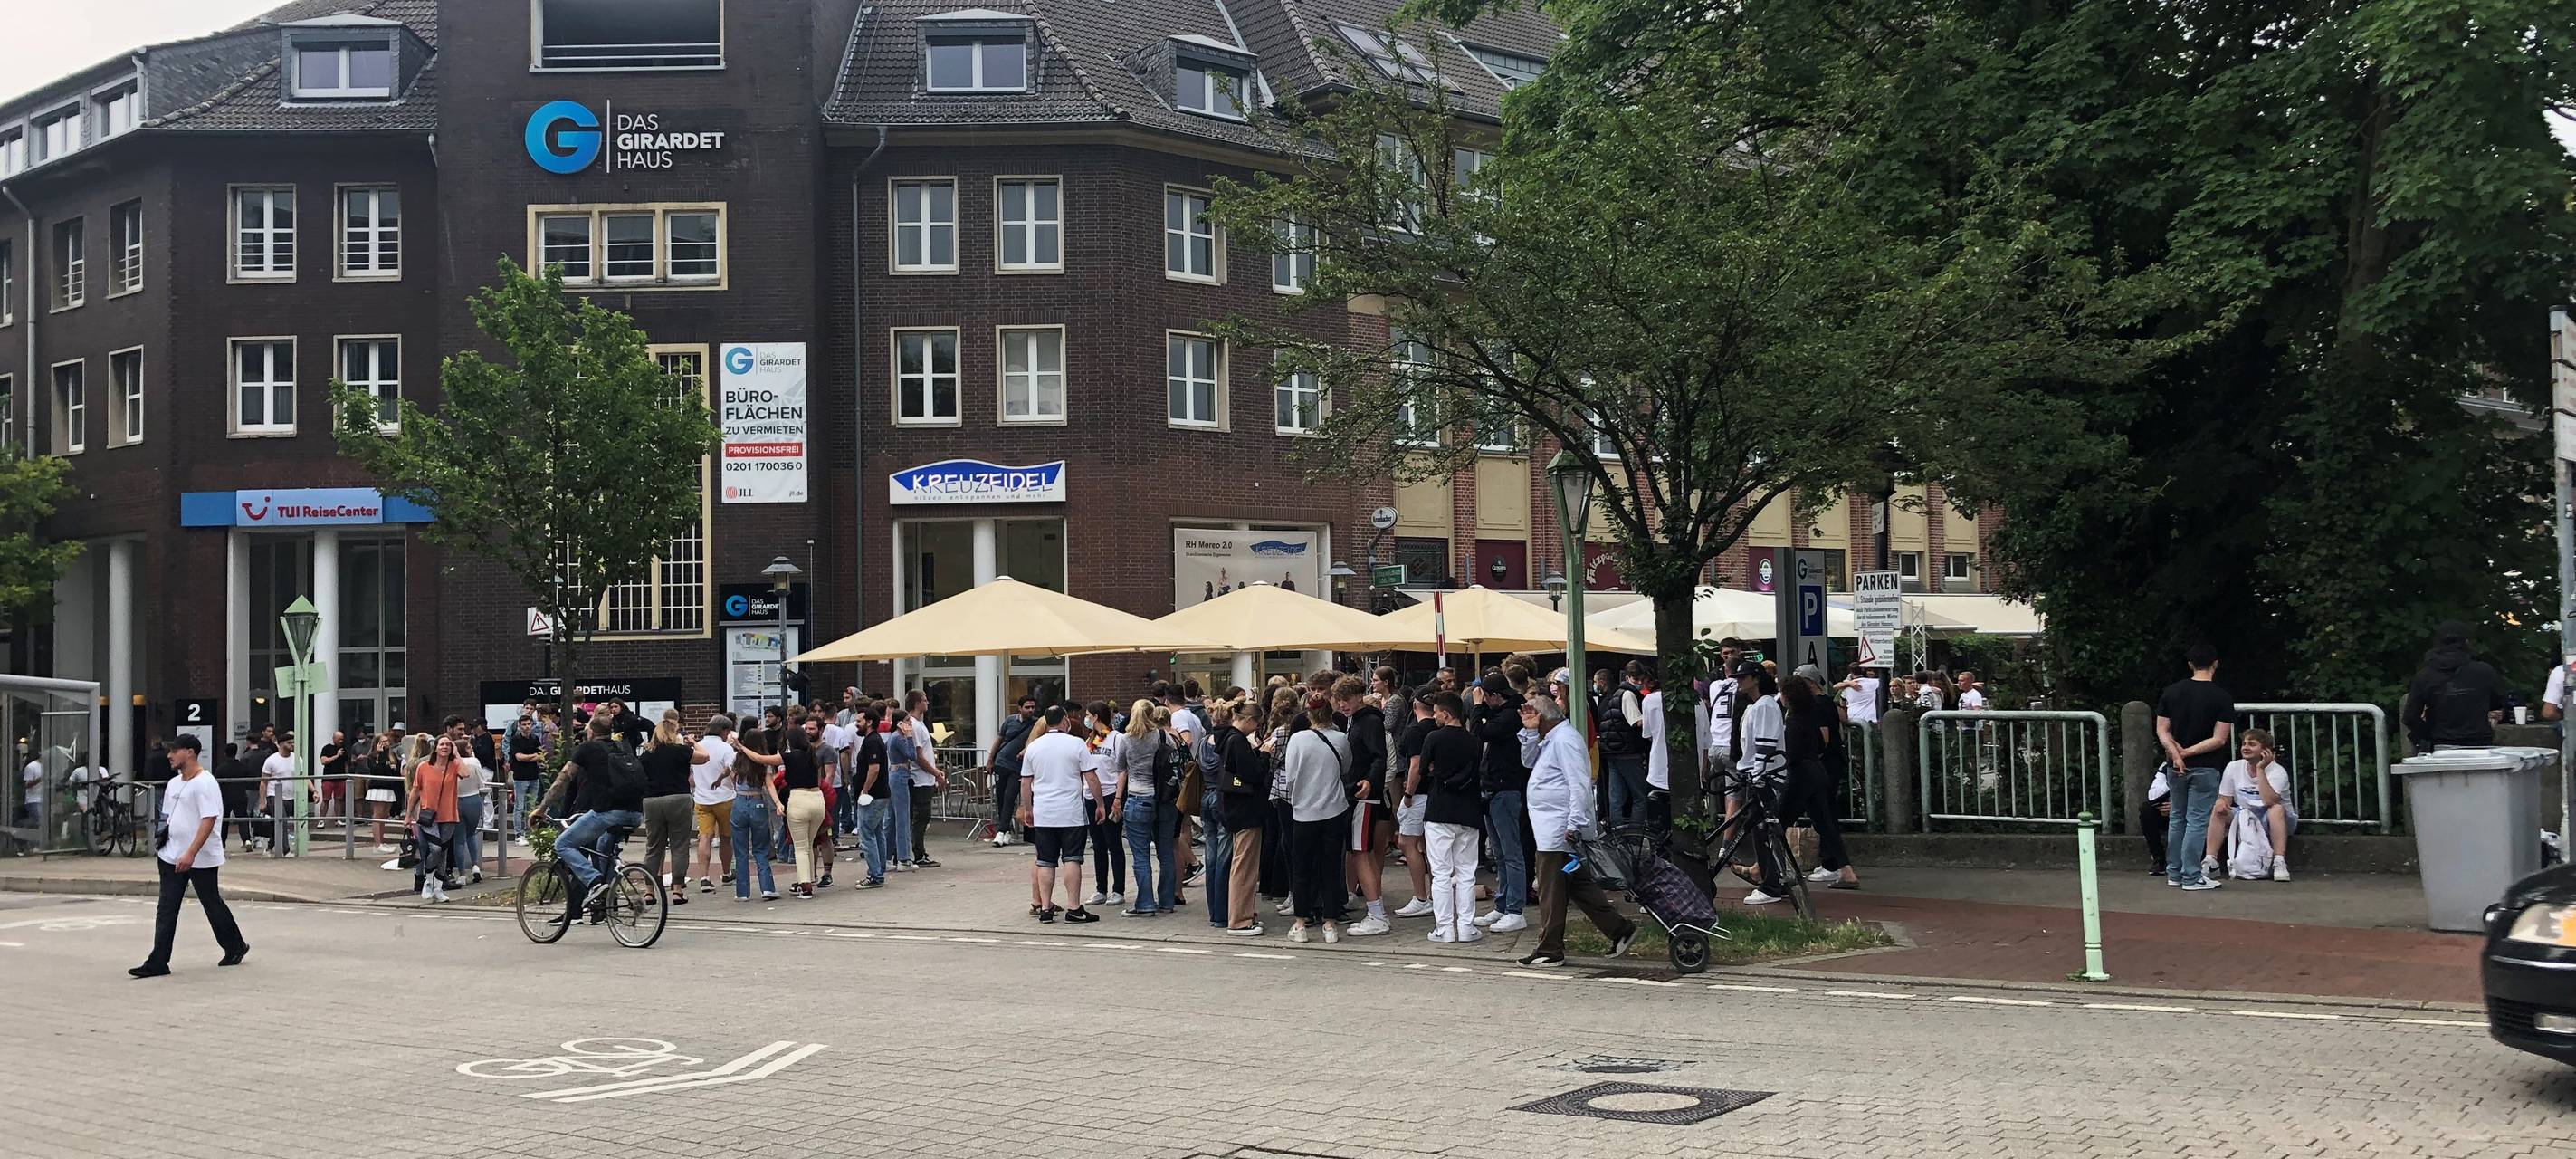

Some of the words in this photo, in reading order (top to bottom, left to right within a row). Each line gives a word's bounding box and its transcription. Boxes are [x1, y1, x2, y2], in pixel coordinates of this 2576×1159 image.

[617, 114, 659, 131] DAS
[525, 101, 602, 175] G
[617, 132, 725, 150] GIRARDET
[617, 151, 673, 168] HAUS
[725, 347, 754, 375] G
[726, 388, 778, 403] BÜRO-
[726, 404, 803, 420] FLÄCHEN
[725, 426, 739, 435] ZU
[742, 426, 804, 435] VERMIETEN
[728, 445, 799, 455] PROVISIONSFREI
[726, 462, 751, 471] 0201
[277, 506, 300, 517] TUI
[303, 505, 378, 517] ReiseCenter
[1185, 541, 1197, 549] RH
[1198, 541, 1220, 550] Mereo
[1856, 573, 1898, 591] PARKEN
[1803, 592, 1818, 629] P
[529, 686, 548, 696] DA
[188, 704, 201, 721] 2
